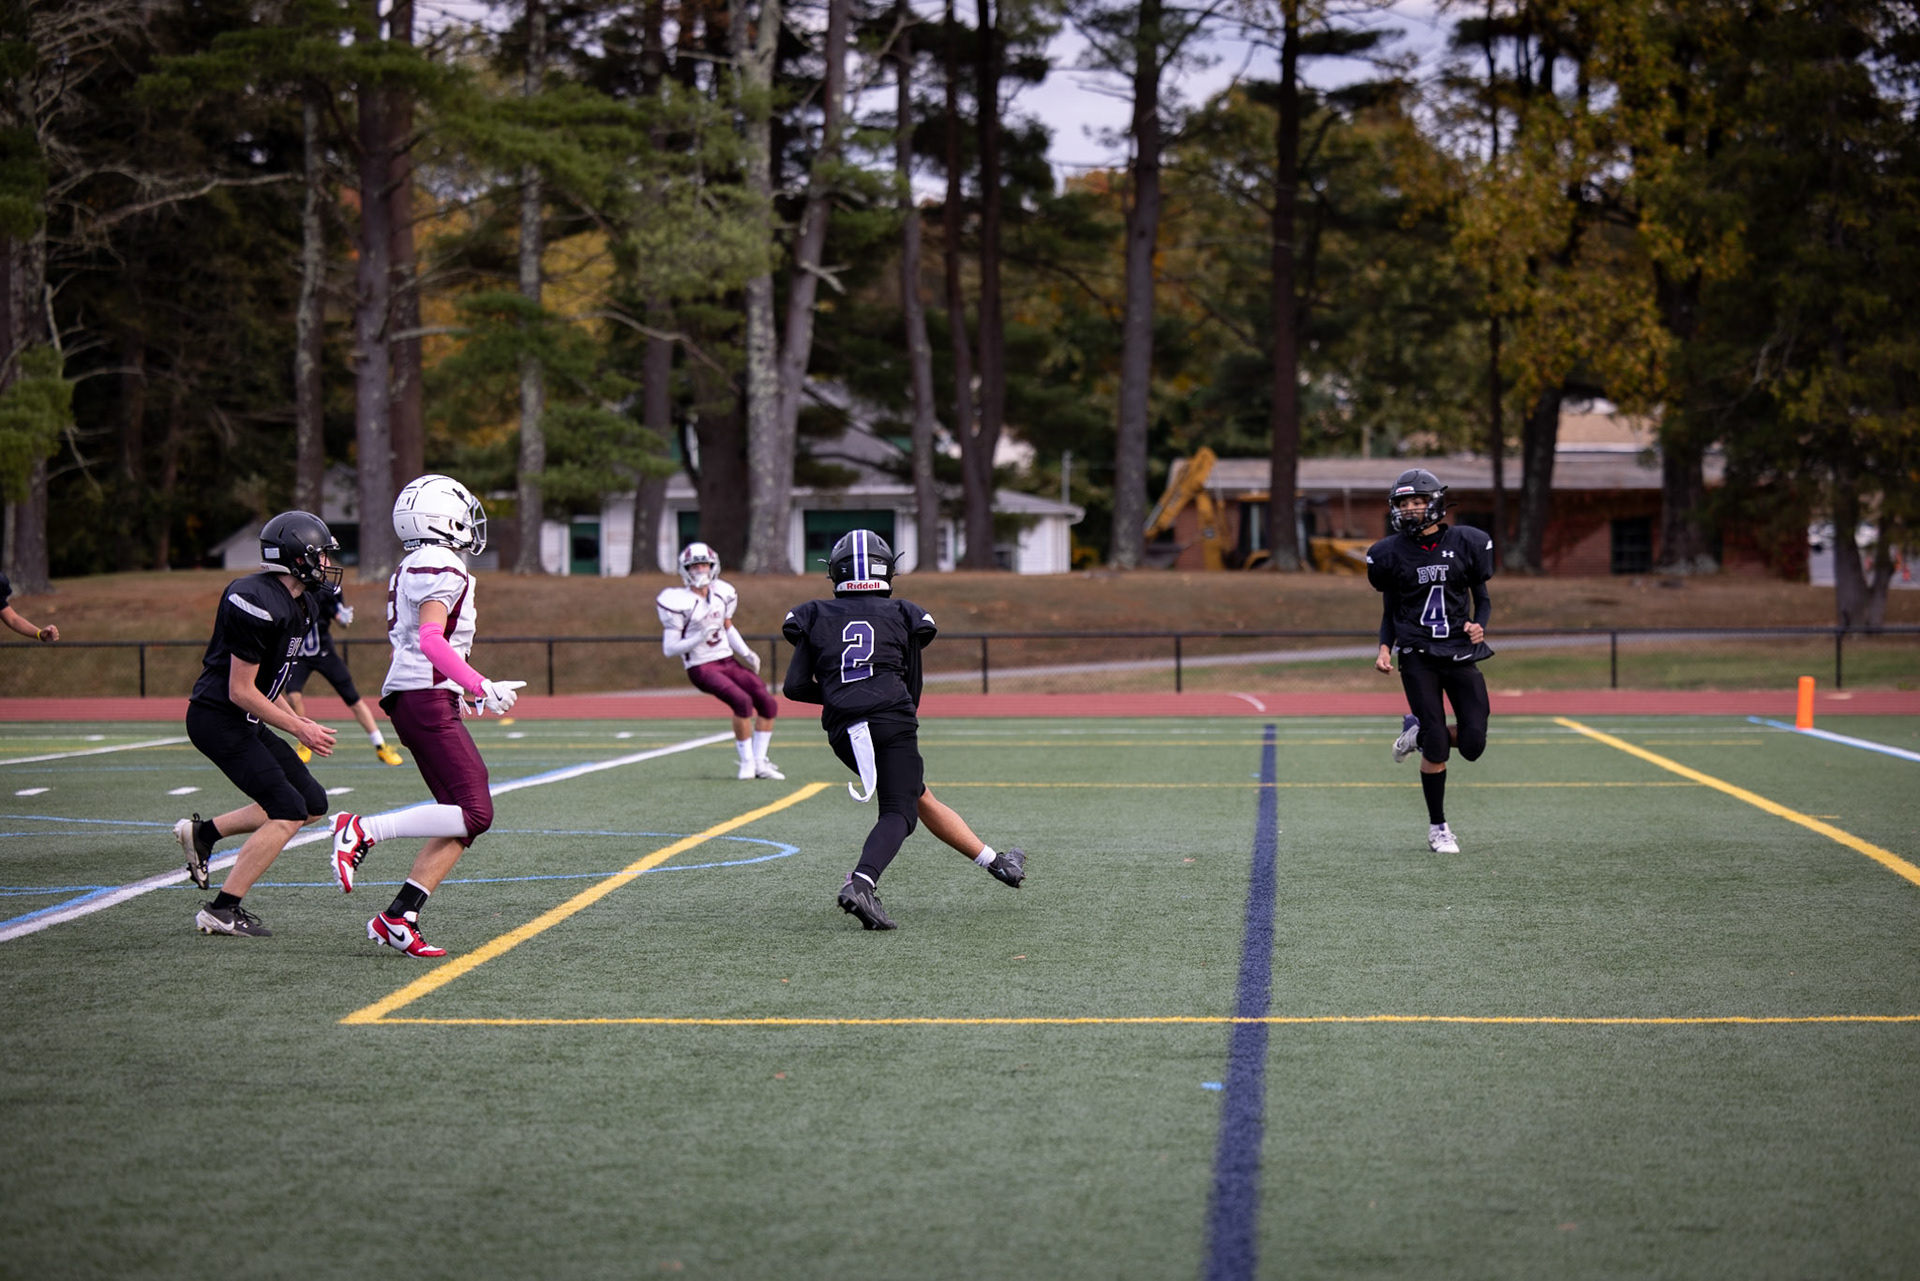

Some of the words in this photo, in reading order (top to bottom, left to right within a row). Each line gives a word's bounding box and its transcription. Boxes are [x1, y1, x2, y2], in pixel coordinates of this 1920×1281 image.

[846, 582, 880, 590] Riddell
[1416, 565, 1449, 584] BVT
[1420, 585, 1450, 638] 4
[841, 621, 875, 683] 2
